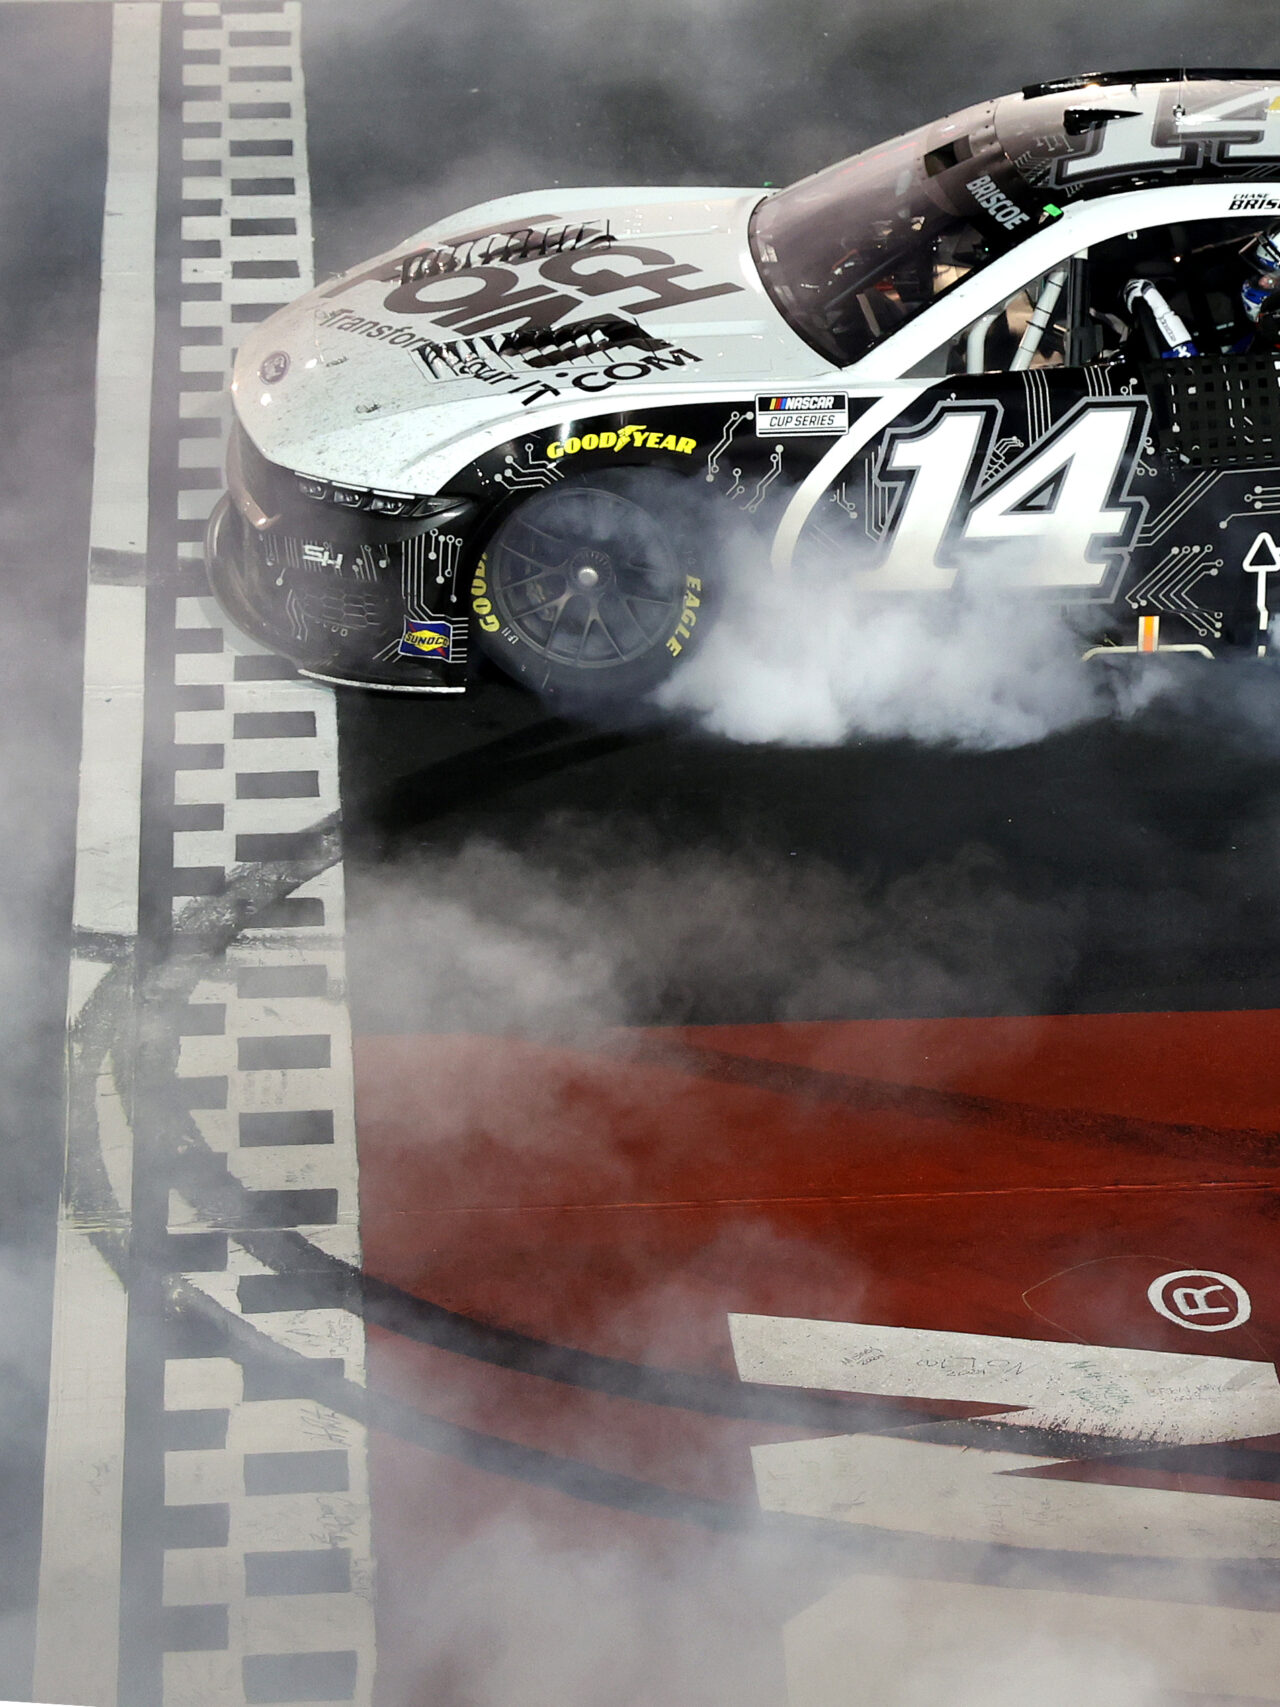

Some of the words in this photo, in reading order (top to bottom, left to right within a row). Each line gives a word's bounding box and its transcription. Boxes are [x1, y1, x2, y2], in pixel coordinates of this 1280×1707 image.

[966, 175, 1031, 230] BRISCOE
[508, 379, 561, 406] IT
[785, 397, 834, 409] NASCAR
[769, 416, 793, 427] CUP
[794, 414, 835, 426] SERIES
[860, 398, 1145, 600] 14
[665, 574, 702, 657] EAGLE
[405, 631, 450, 647] SUNOCO
